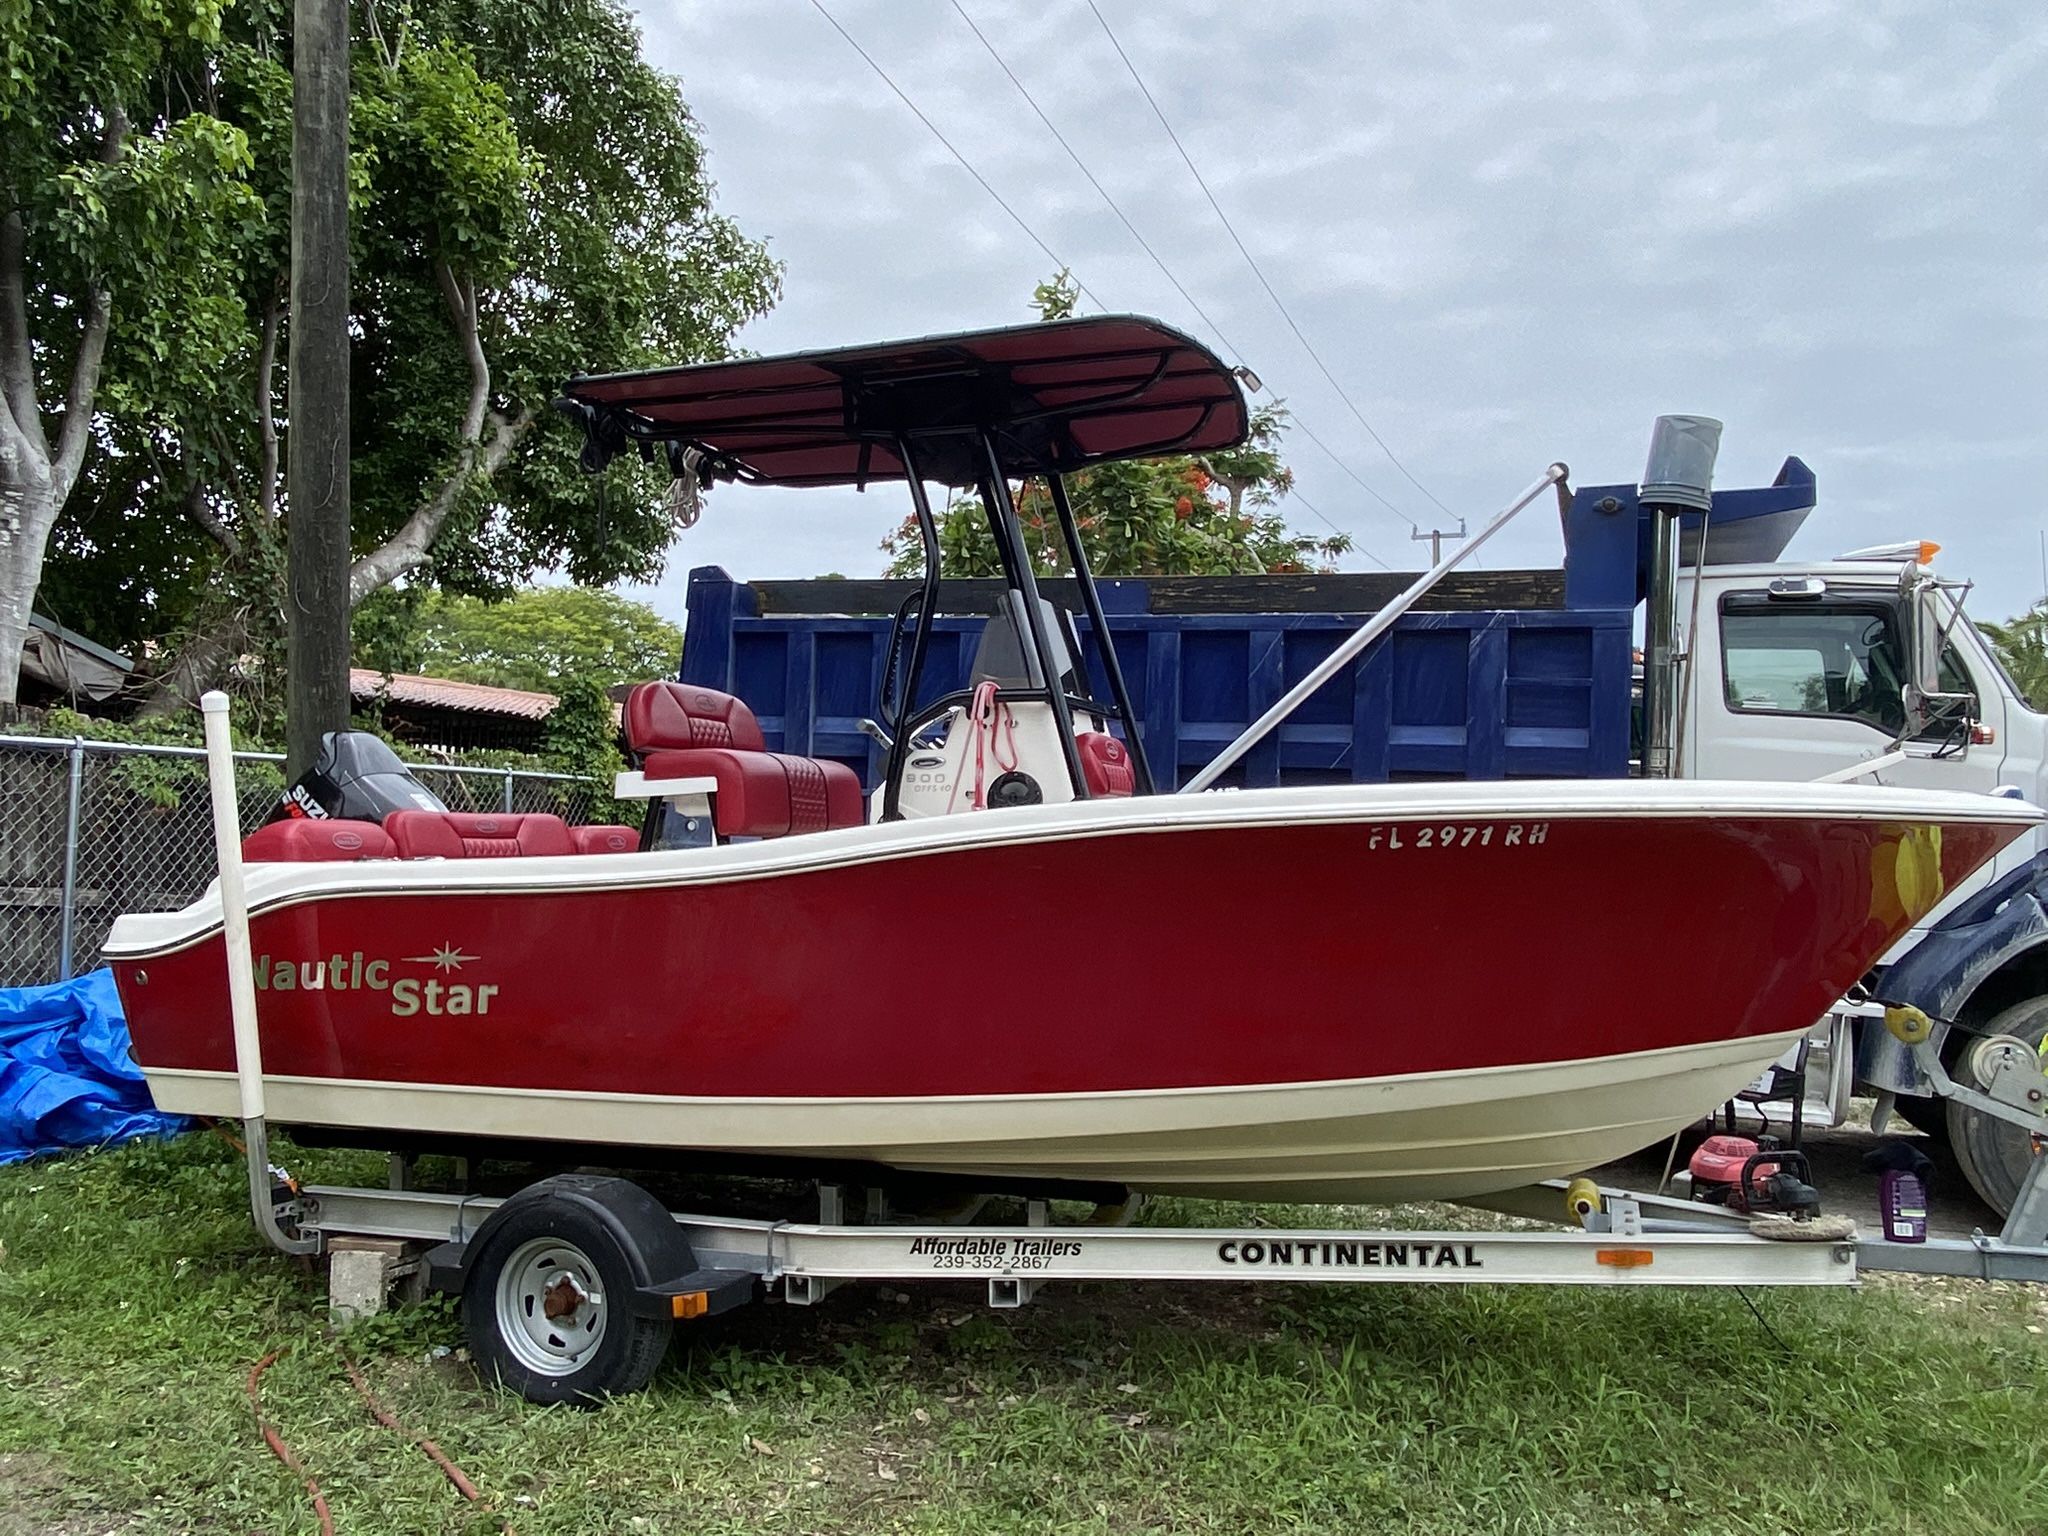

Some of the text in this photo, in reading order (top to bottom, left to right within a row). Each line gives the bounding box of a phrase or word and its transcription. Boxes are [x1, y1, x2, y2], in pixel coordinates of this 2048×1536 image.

[1369, 823, 1549, 850] FL 2971 RH
[253, 951, 389, 991] Nautic
[392, 979, 499, 1016] Star
[910, 1237, 1083, 1256] Affordable Trailers
[1218, 1241, 1484, 1267] CONTINENTAL
[933, 1255, 1053, 1269] 239-352-2867
